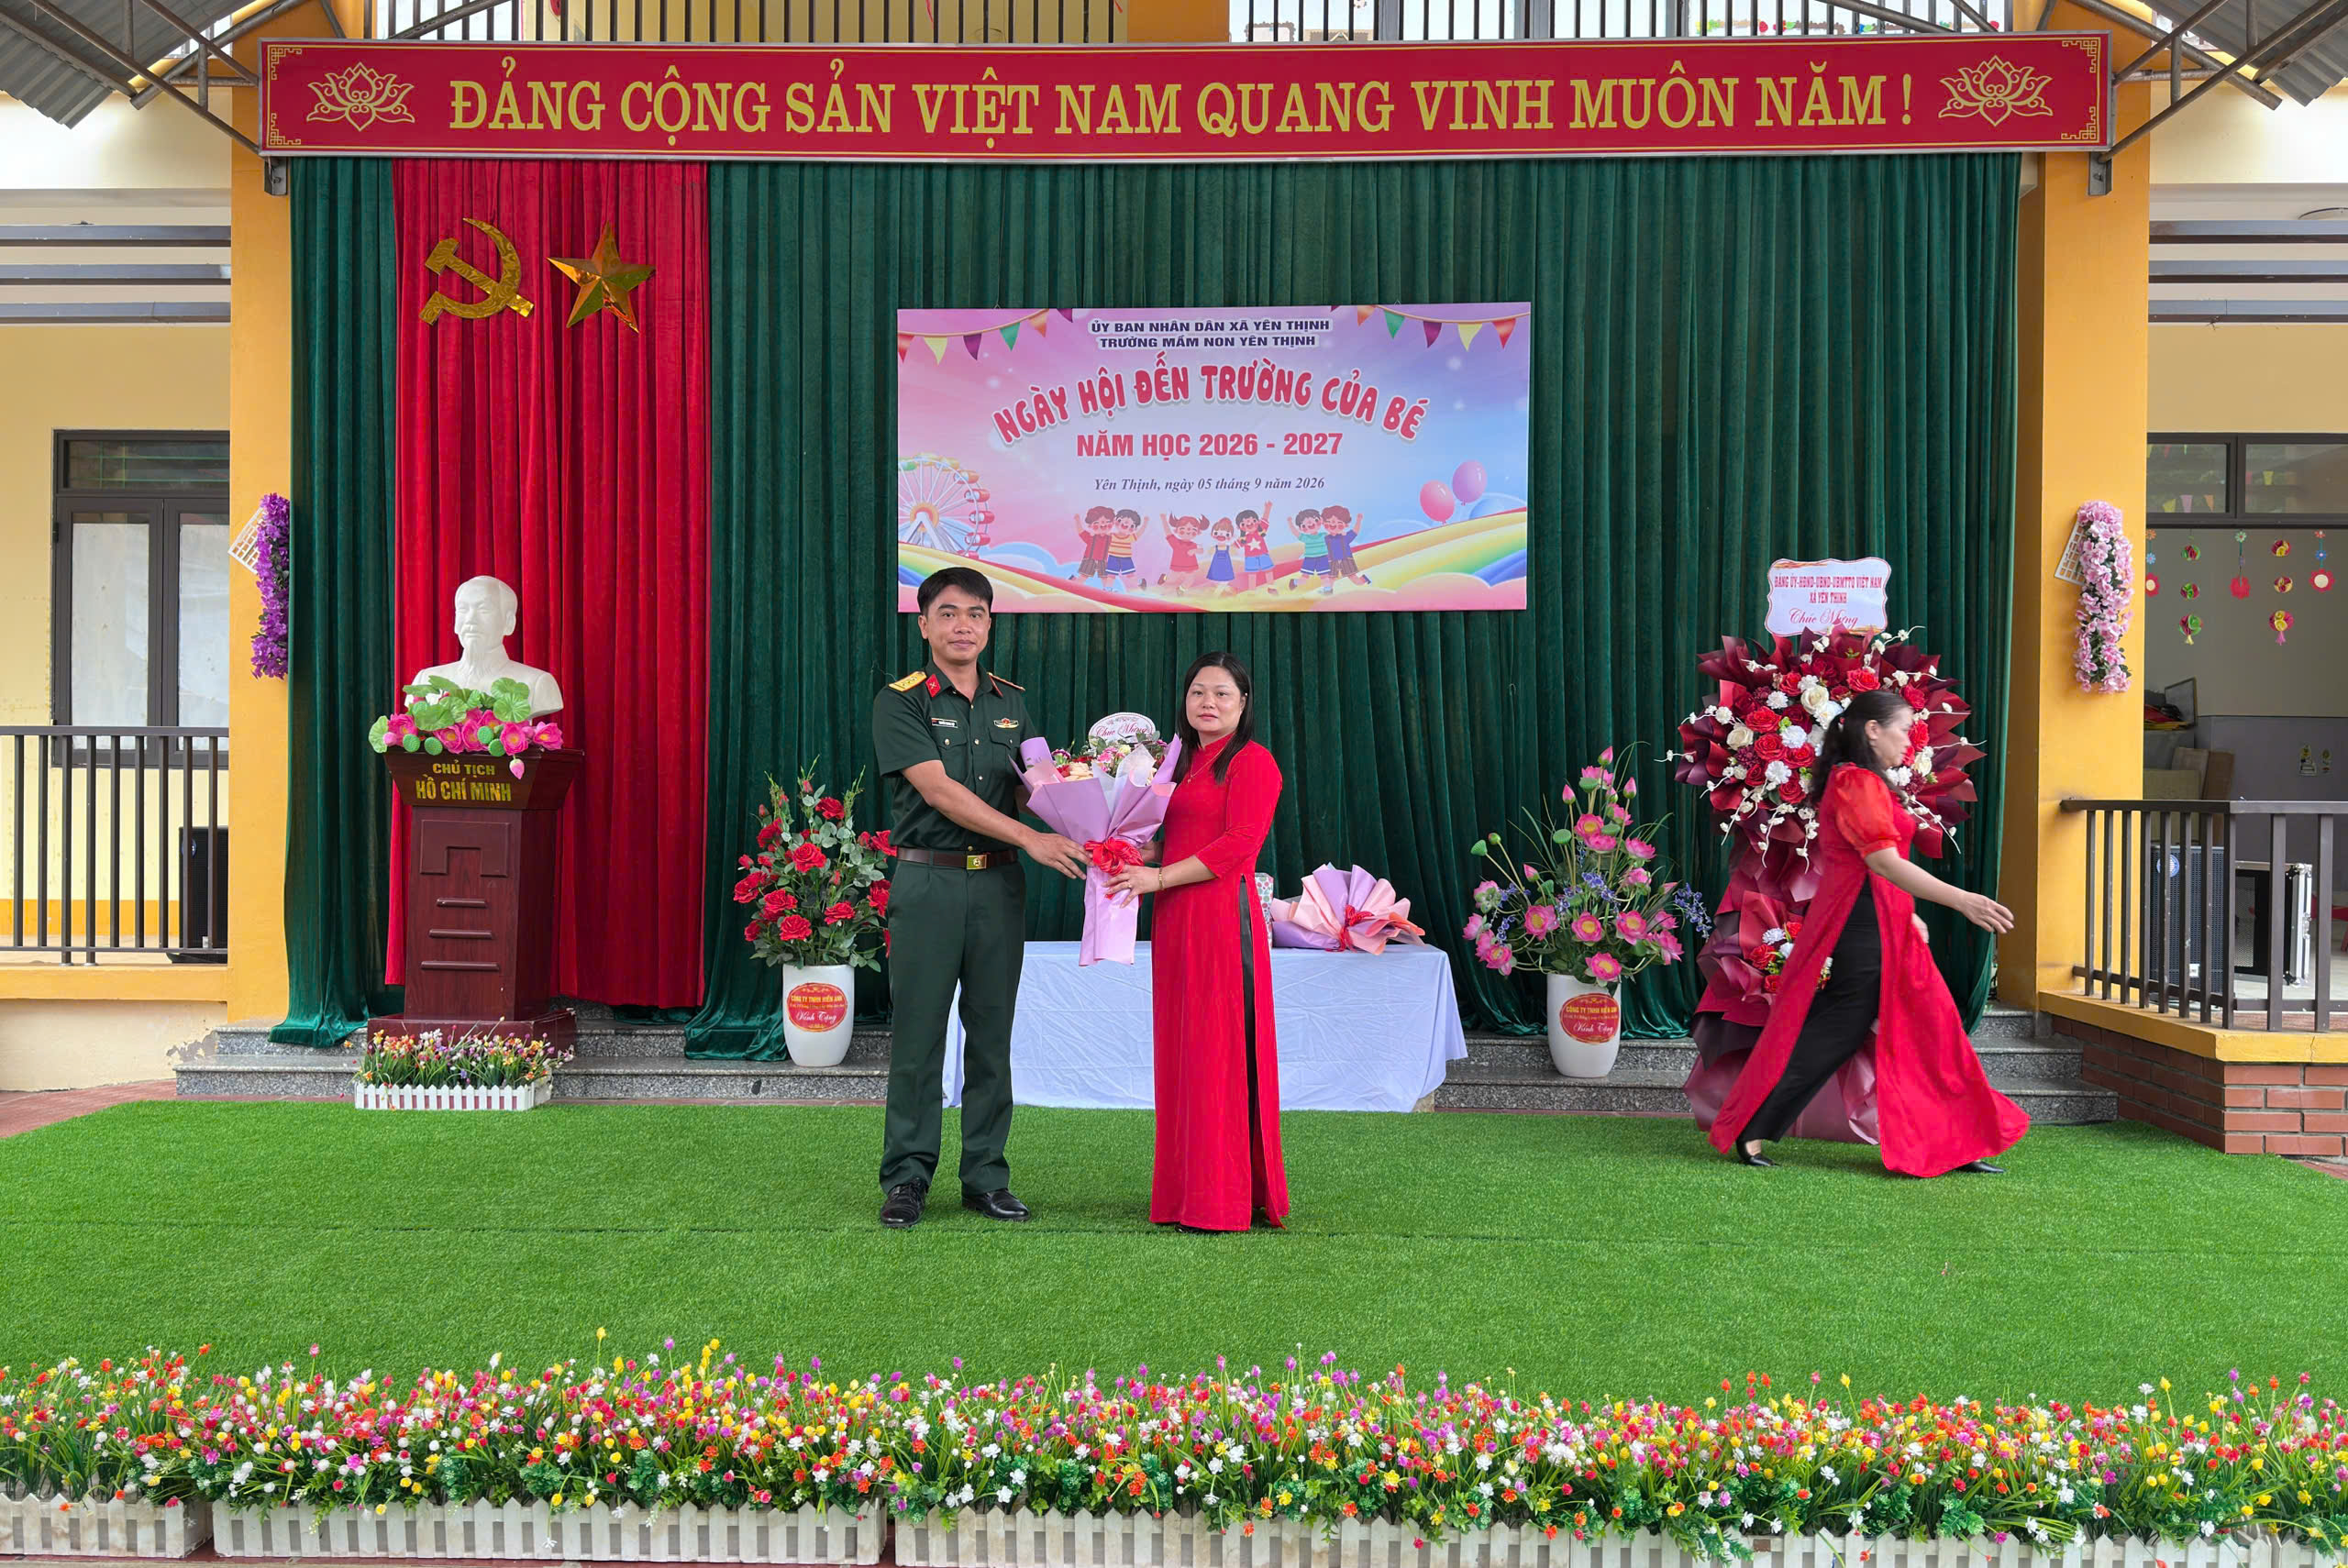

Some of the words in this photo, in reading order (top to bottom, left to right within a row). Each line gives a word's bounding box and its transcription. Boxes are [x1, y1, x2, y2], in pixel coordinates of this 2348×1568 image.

[450, 57, 605, 130] ĐẢNG
[621, 65, 771, 146] CỘNG
[786, 58, 896, 133] SẢN
[914, 66, 1039, 148] VIỆT
[1057, 84, 1182, 134] NAM
[1197, 81, 1395, 137] QUANG
[1412, 80, 1554, 131] VINH
[1569, 61, 1740, 128] MUÔN
[1755, 62, 1887, 126] NĂM
[1902, 73, 1911, 126] !
[1091, 320, 1110, 333] ỦY
[1114, 322, 1145, 333] BAN
[1149, 319, 1191, 333] NHÂN
[1195, 319, 1224, 332] DÂN
[1229, 319, 1248, 332] XÃ
[1254, 318, 1281, 331] YÊN
[1286, 320, 1330, 333] THỊNH
[1101, 335, 1157, 348] TRƯỜNG
[1204, 337, 1235, 348] NON
[1240, 335, 1268, 347] YÊN
[1272, 336, 1315, 348] THỊNH
[992, 385, 1069, 443] NGÀY
[1077, 366, 1126, 417] HỘI
[1133, 350, 1190, 404] ĐẾN
[1201, 358, 1312, 406] TRƯỜNG
[1321, 369, 1379, 423] CỦA
[1382, 396, 1429, 439] BÉ
[1077, 429, 1134, 457] NĂM
[1142, 433, 1191, 461] HỌC
[1199, 433, 1258, 457] 2026
[1284, 433, 1343, 456] 2027
[1094, 479, 1116, 490] Yên
[1121, 479, 1161, 492] Thịnh,
[1165, 479, 1193, 492] ngày
[1198, 478, 1212, 490] 05
[1215, 478, 1250, 492] tháng
[1255, 478, 1262, 490] 9
[1265, 478, 1291, 489] năm
[1295, 477, 1325, 489] 2026
[1789, 607, 1817, 624] Chúc
[433, 759, 460, 775] CHỦ
[464, 763, 496, 778] TỊCH
[415, 774, 437, 800] HỒ
[440, 777, 467, 801] CHÍ
[471, 782, 511, 801] MINH
[795, 1010, 814, 1021] Kính
[817, 1010, 837, 1025] Tặng
[1573, 1020, 1594, 1032] Kính
